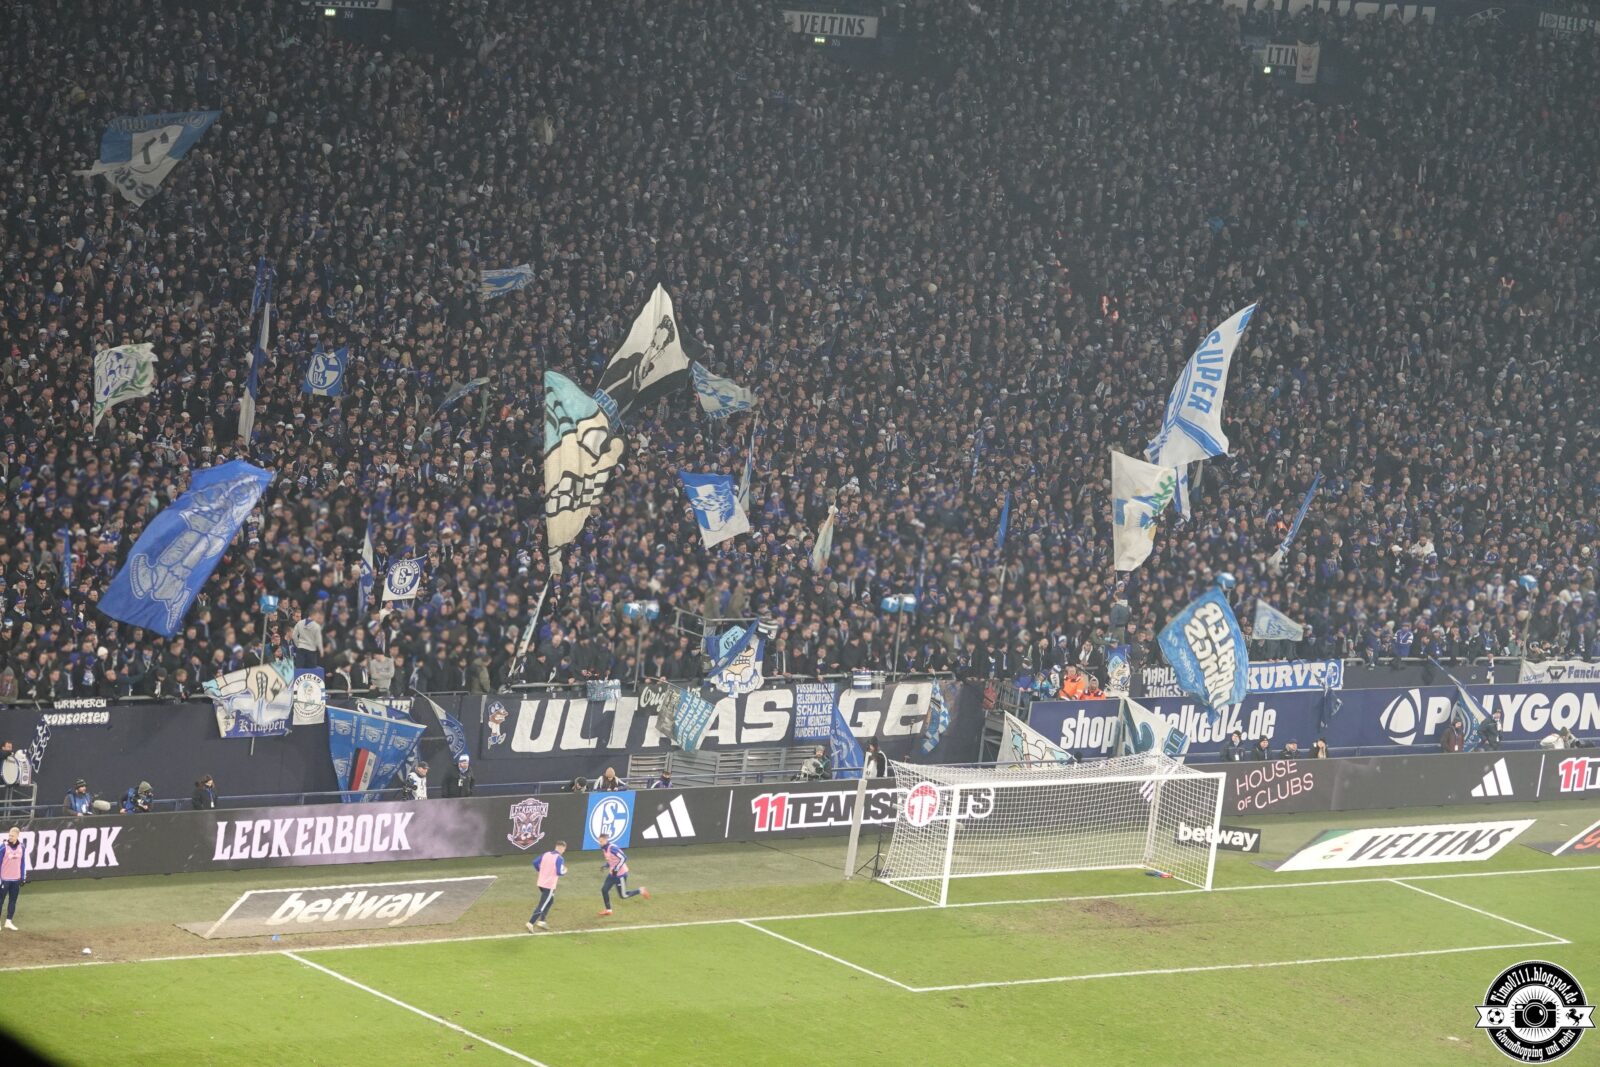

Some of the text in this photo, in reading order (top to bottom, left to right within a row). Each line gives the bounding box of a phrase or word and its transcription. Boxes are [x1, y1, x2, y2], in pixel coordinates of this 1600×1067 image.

[800, 14, 865, 36] VELTINS
[1268, 46, 1298, 65] LTIN
[1187, 330, 1224, 414] SUPER
[1141, 667, 1178, 687] MARLE
[1567, 665, 1600, 679] Fanclu
[796, 704, 833, 716] SCHALKE
[1424, 692, 1600, 735] PYGON
[238, 719, 286, 734] Knappen
[1236, 760, 1298, 795] HOUSE
[1237, 773, 1314, 811] OF CLUBS
[509, 803, 549, 819] LECKERBOCK
[212, 812, 415, 861] LECKERBOCK
[1178, 822, 1259, 852] betway
[1346, 827, 1514, 862] VELTINS
[265, 890, 445, 926] betway
